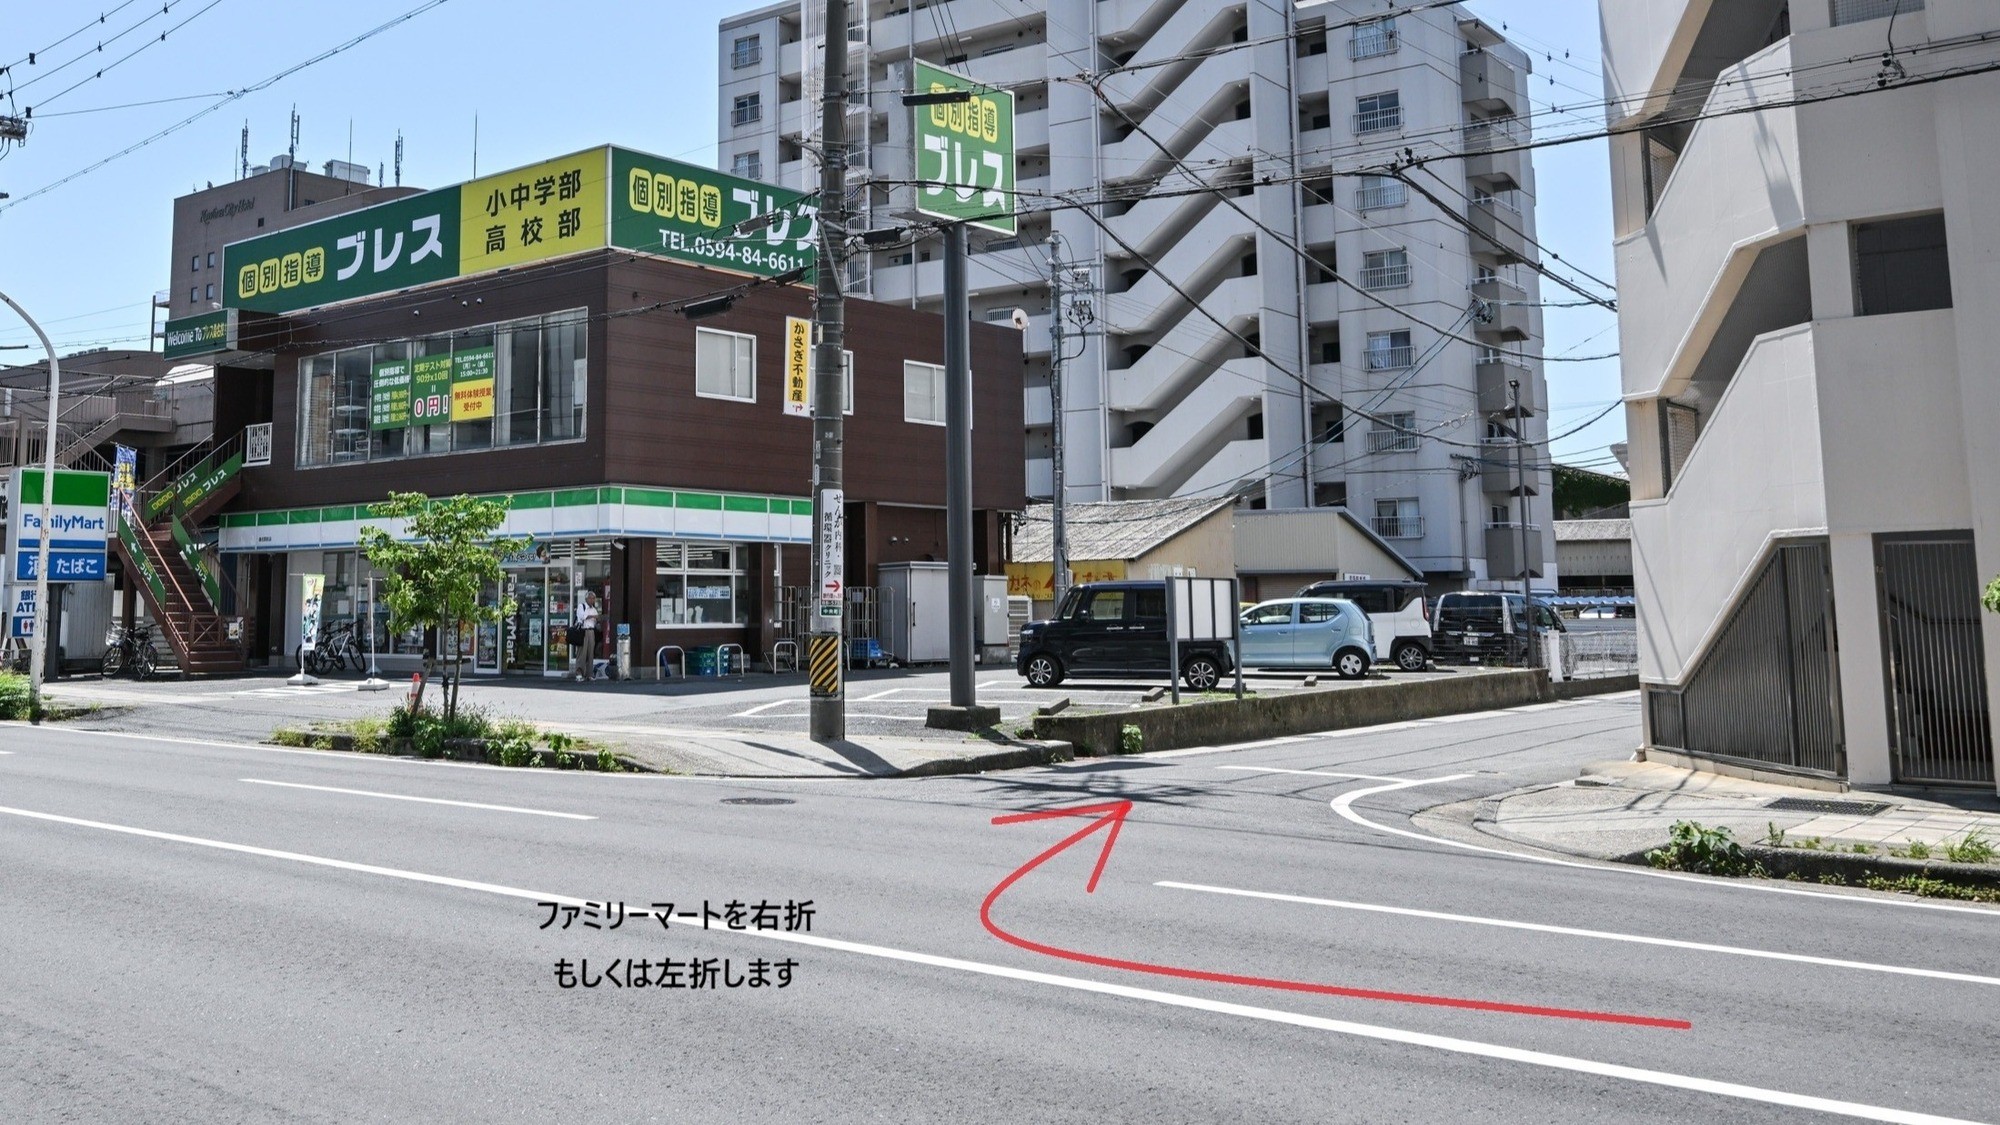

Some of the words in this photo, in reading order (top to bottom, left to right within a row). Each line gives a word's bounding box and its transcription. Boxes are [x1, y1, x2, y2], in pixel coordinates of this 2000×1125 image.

[486, 168, 582, 217] 小中学部
[924, 133, 1006, 213] ブレス
[632, 174, 720, 229] 個別指導
[337, 213, 443, 281] ブレス
[485, 208, 582, 256] 高校部
[241, 252, 322, 295] 個別指導
[167, 331, 194, 347] Welcome
[791, 322, 804, 402] かさぎ不動産
[56, 558, 98, 575] たばこ
[16, 602, 36, 612] AT
